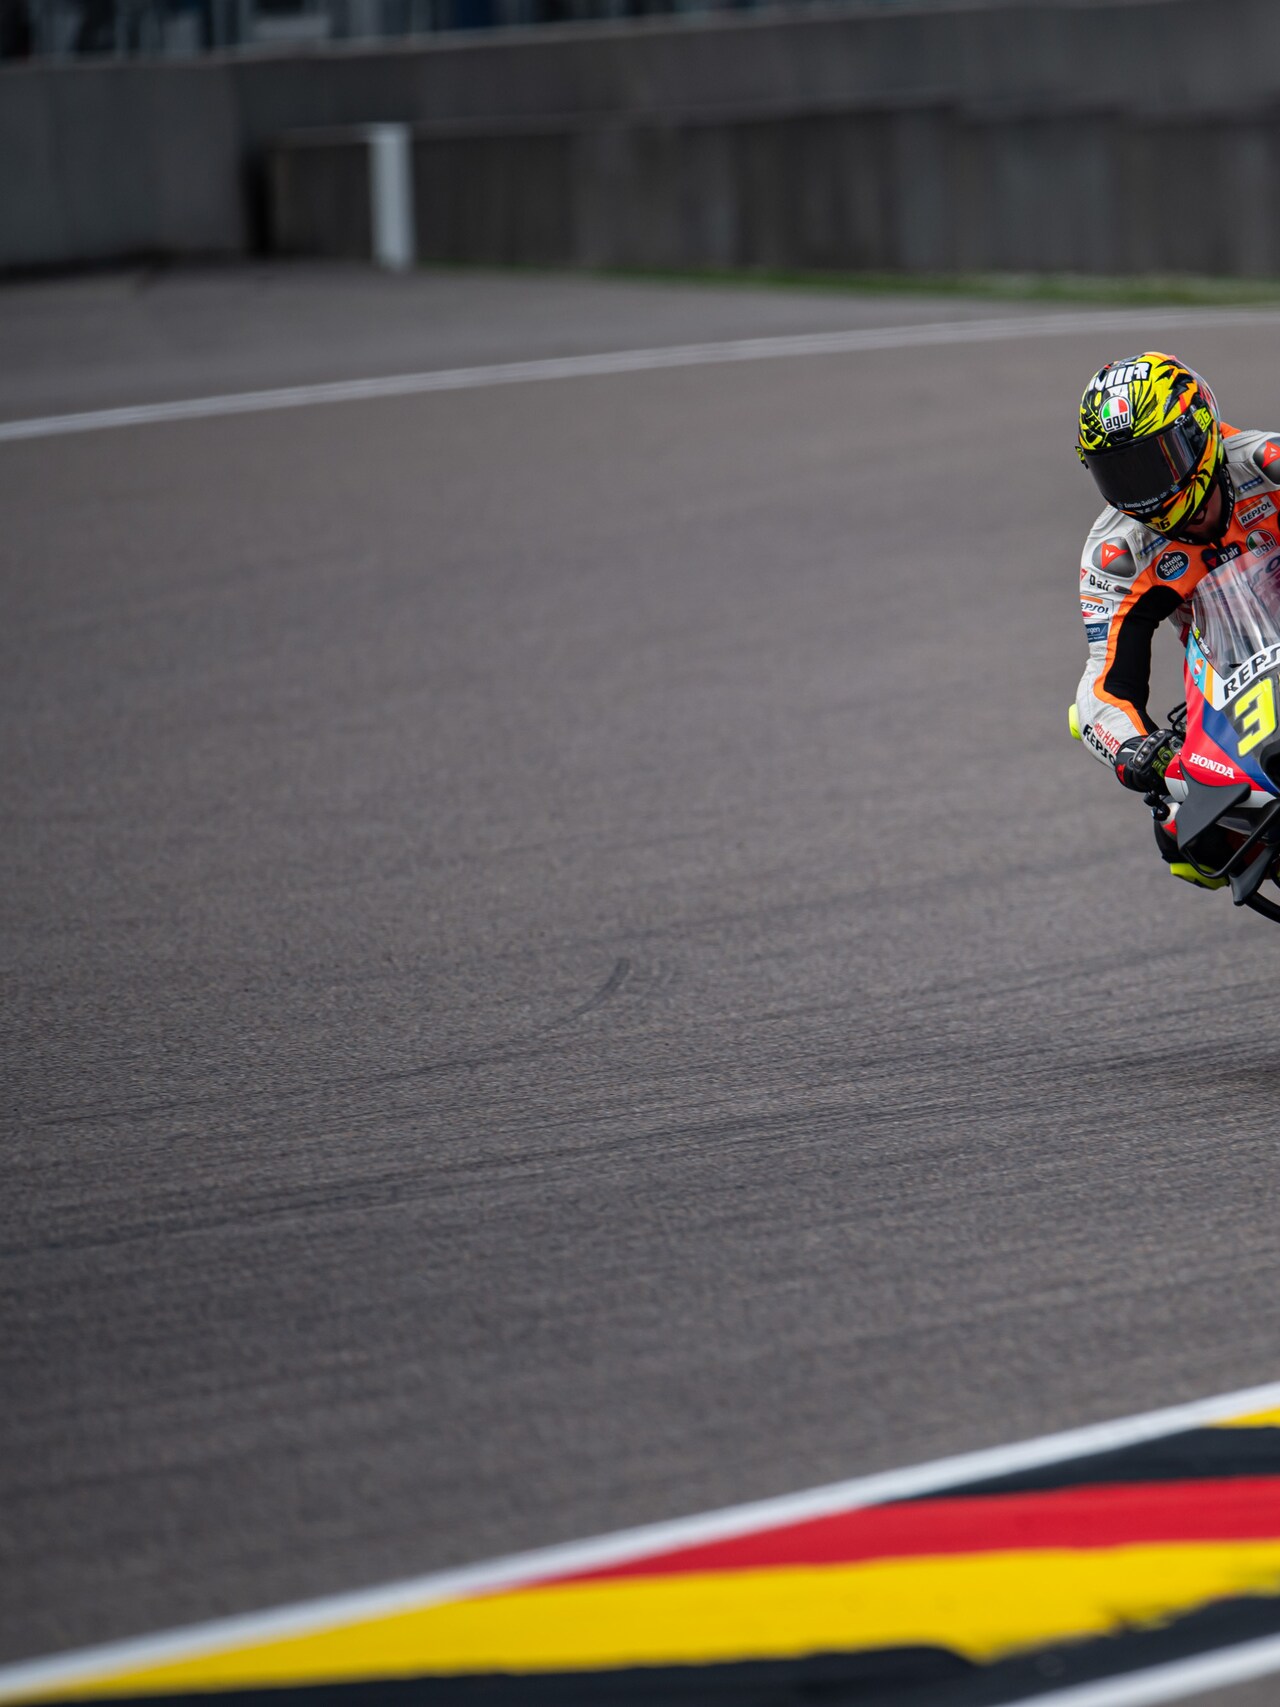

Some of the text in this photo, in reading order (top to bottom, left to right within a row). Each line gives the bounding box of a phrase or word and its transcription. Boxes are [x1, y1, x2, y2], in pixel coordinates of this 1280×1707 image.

[1088, 362, 1151, 391] MIR
[1106, 413, 1128, 430] agv
[1241, 501, 1272, 524] REPSOL
[1255, 540, 1275, 556] agv
[1160, 554, 1183, 571] Estrella
[1164, 560, 1185, 576] Galicia
[1189, 753, 1235, 779] HONDA
